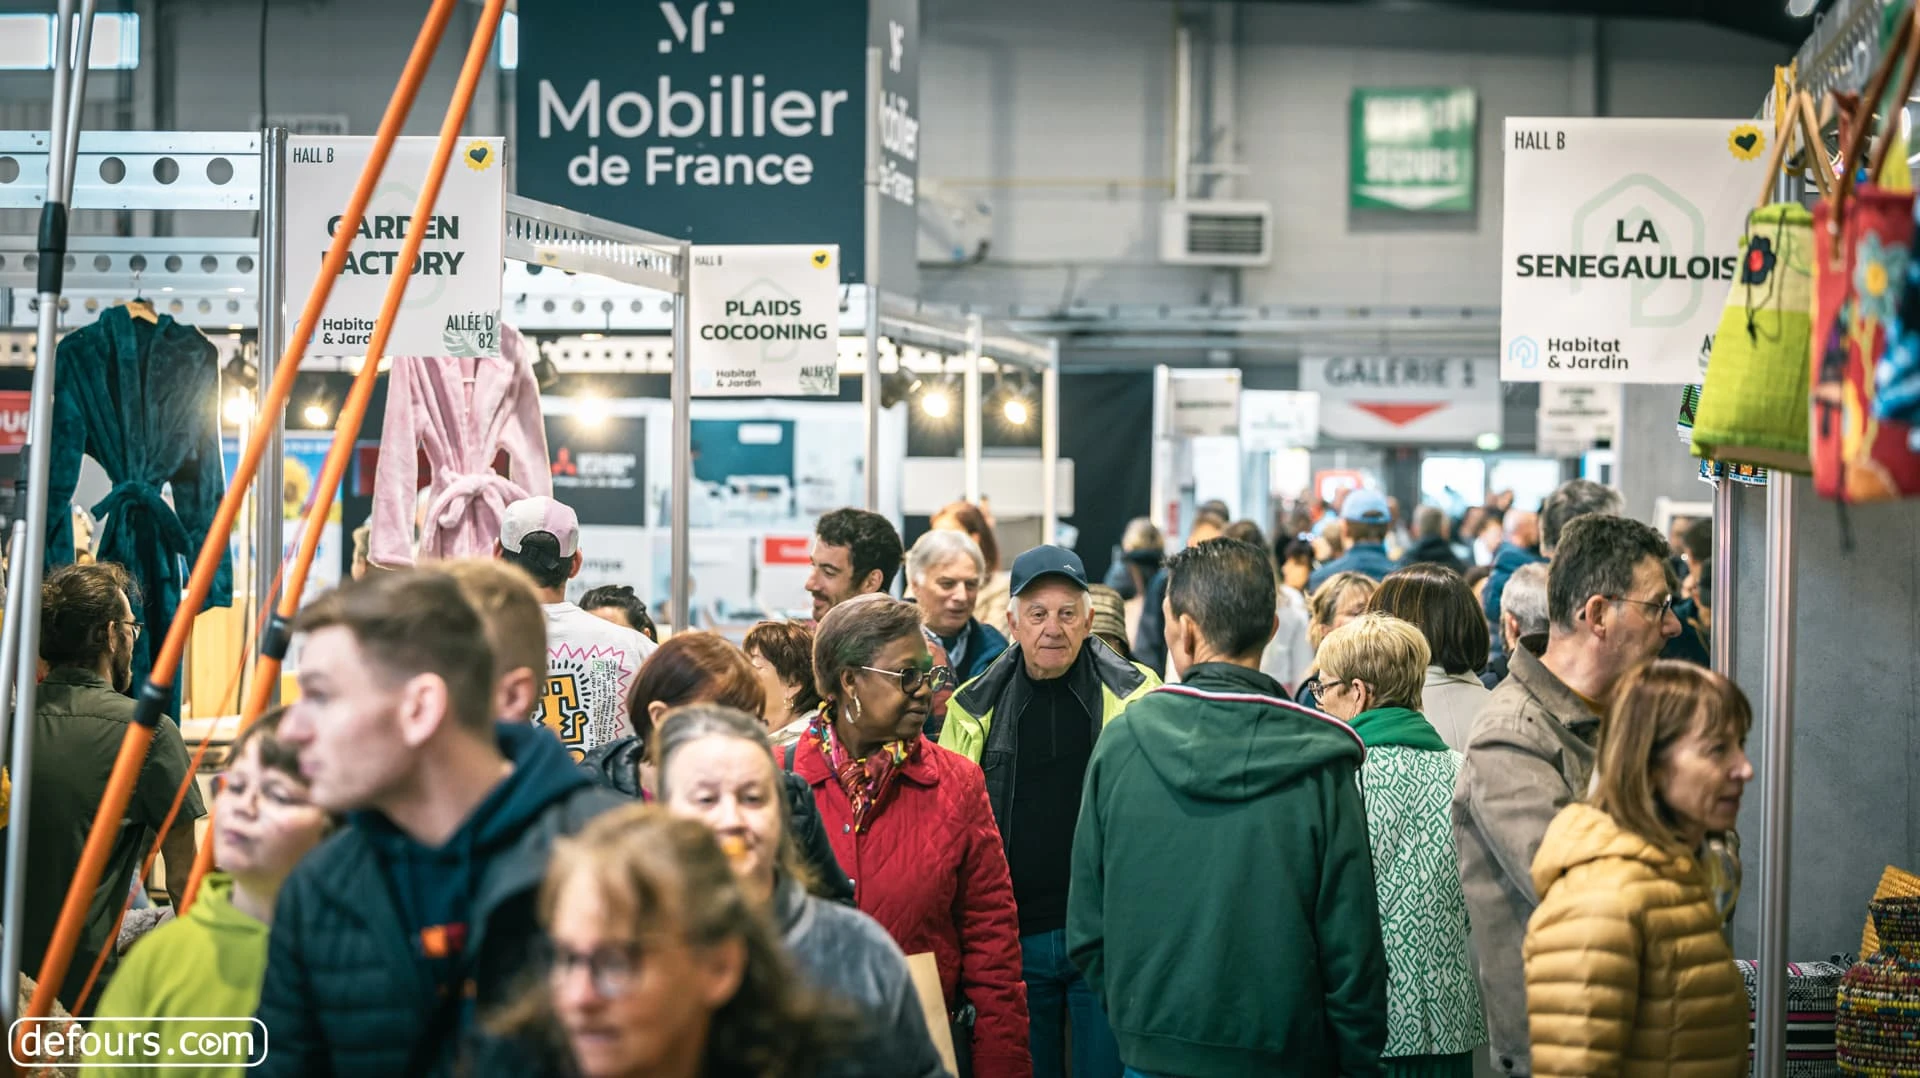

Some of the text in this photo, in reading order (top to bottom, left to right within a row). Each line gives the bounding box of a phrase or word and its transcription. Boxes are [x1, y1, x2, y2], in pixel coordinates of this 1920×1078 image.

[538, 74, 848, 138] Mobilier
[1514, 131, 1566, 150] HALL B
[293, 147, 334, 163] HALL B
[567, 146, 814, 186] de France
[1616, 219, 1660, 243] LA
[321, 250, 465, 275] ACTRY
[725, 300, 802, 316] PLAIDS
[322, 318, 378, 331] Habita
[485, 315, 494, 331] D
[322, 332, 334, 344] &
[700, 324, 828, 340] COCOONING
[478, 332, 494, 349] 82
[1548, 338, 1620, 353] Habitat
[1548, 355, 1629, 370] & Jardin
[1323, 356, 1448, 387] GALERIE
